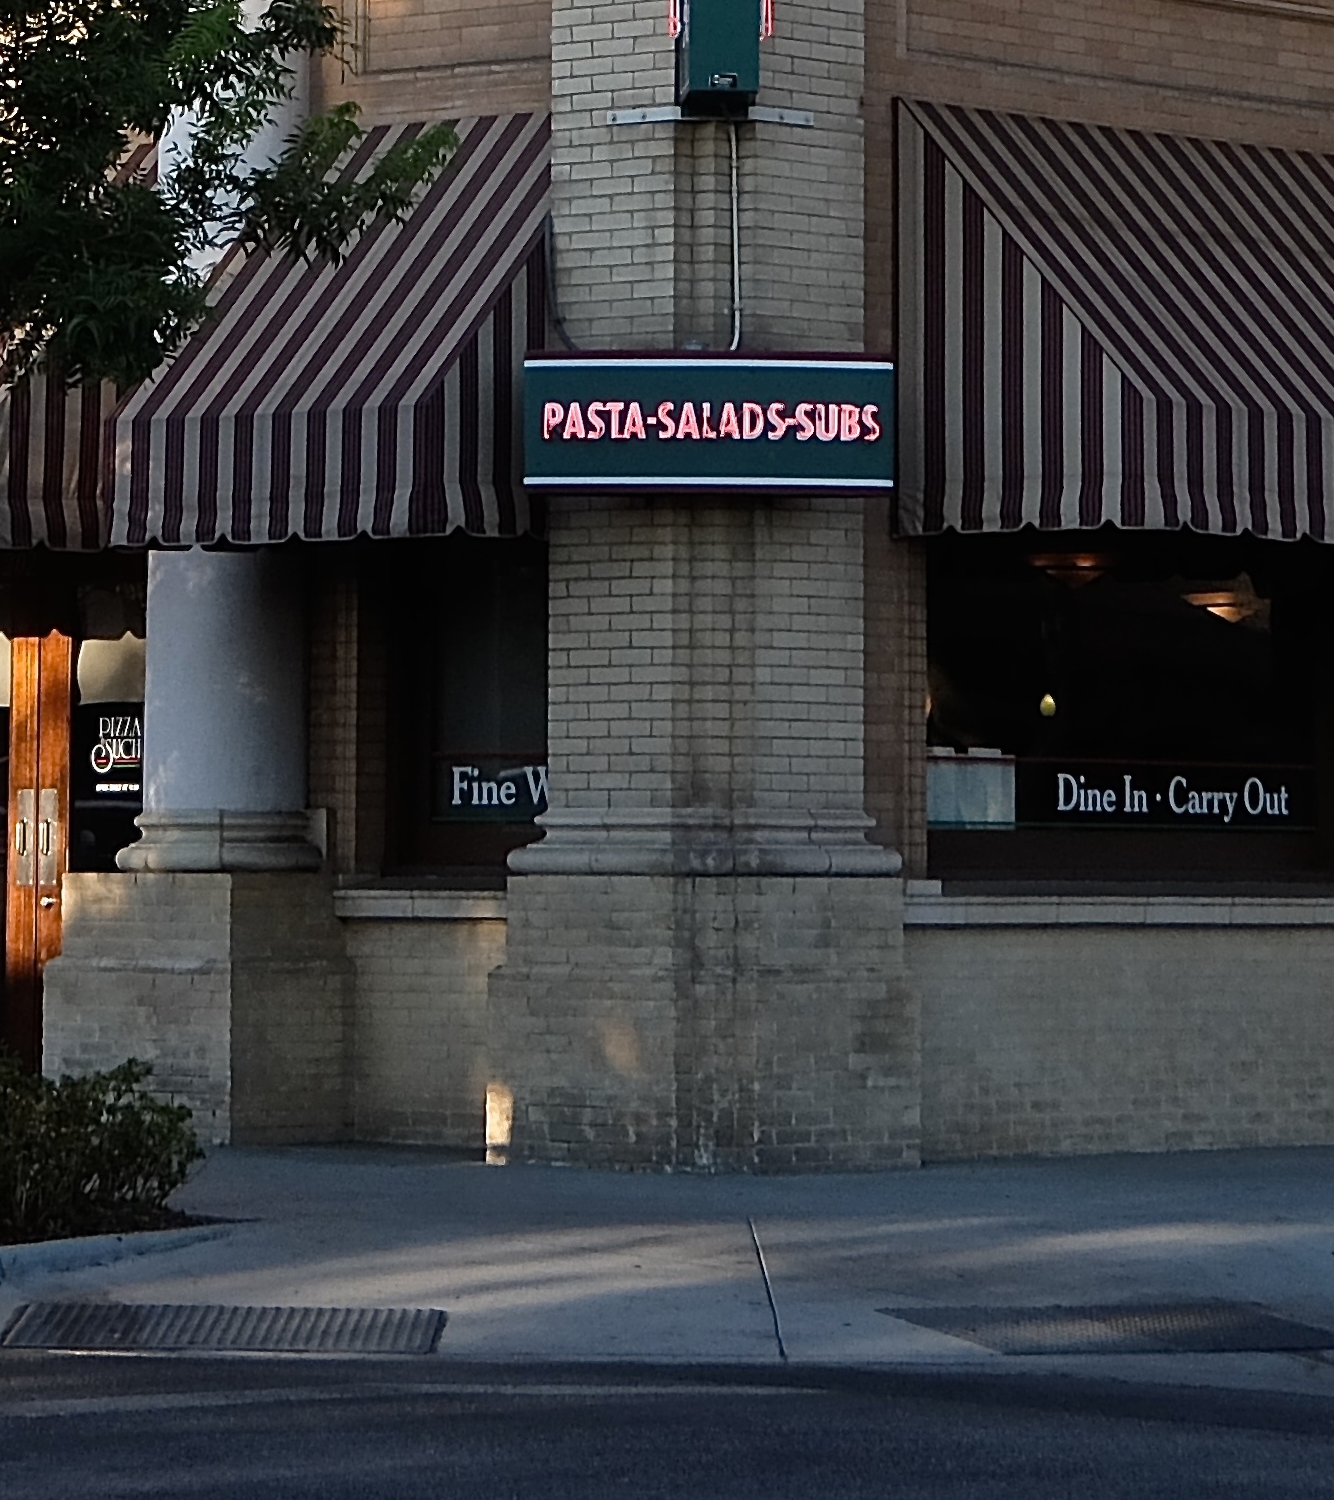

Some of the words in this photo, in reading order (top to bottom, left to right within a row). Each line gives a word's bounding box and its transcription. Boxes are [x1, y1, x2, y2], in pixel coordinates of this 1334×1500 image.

[98, 716, 142, 737] PIZZA
[451, 766, 517, 805] Fine
[523, 766, 548, 805] W
[1057, 773, 1117, 812] Dine
[1123, 775, 1149, 812] In
[1169, 775, 1238, 823] Carry
[1244, 777, 1289, 815] Out
